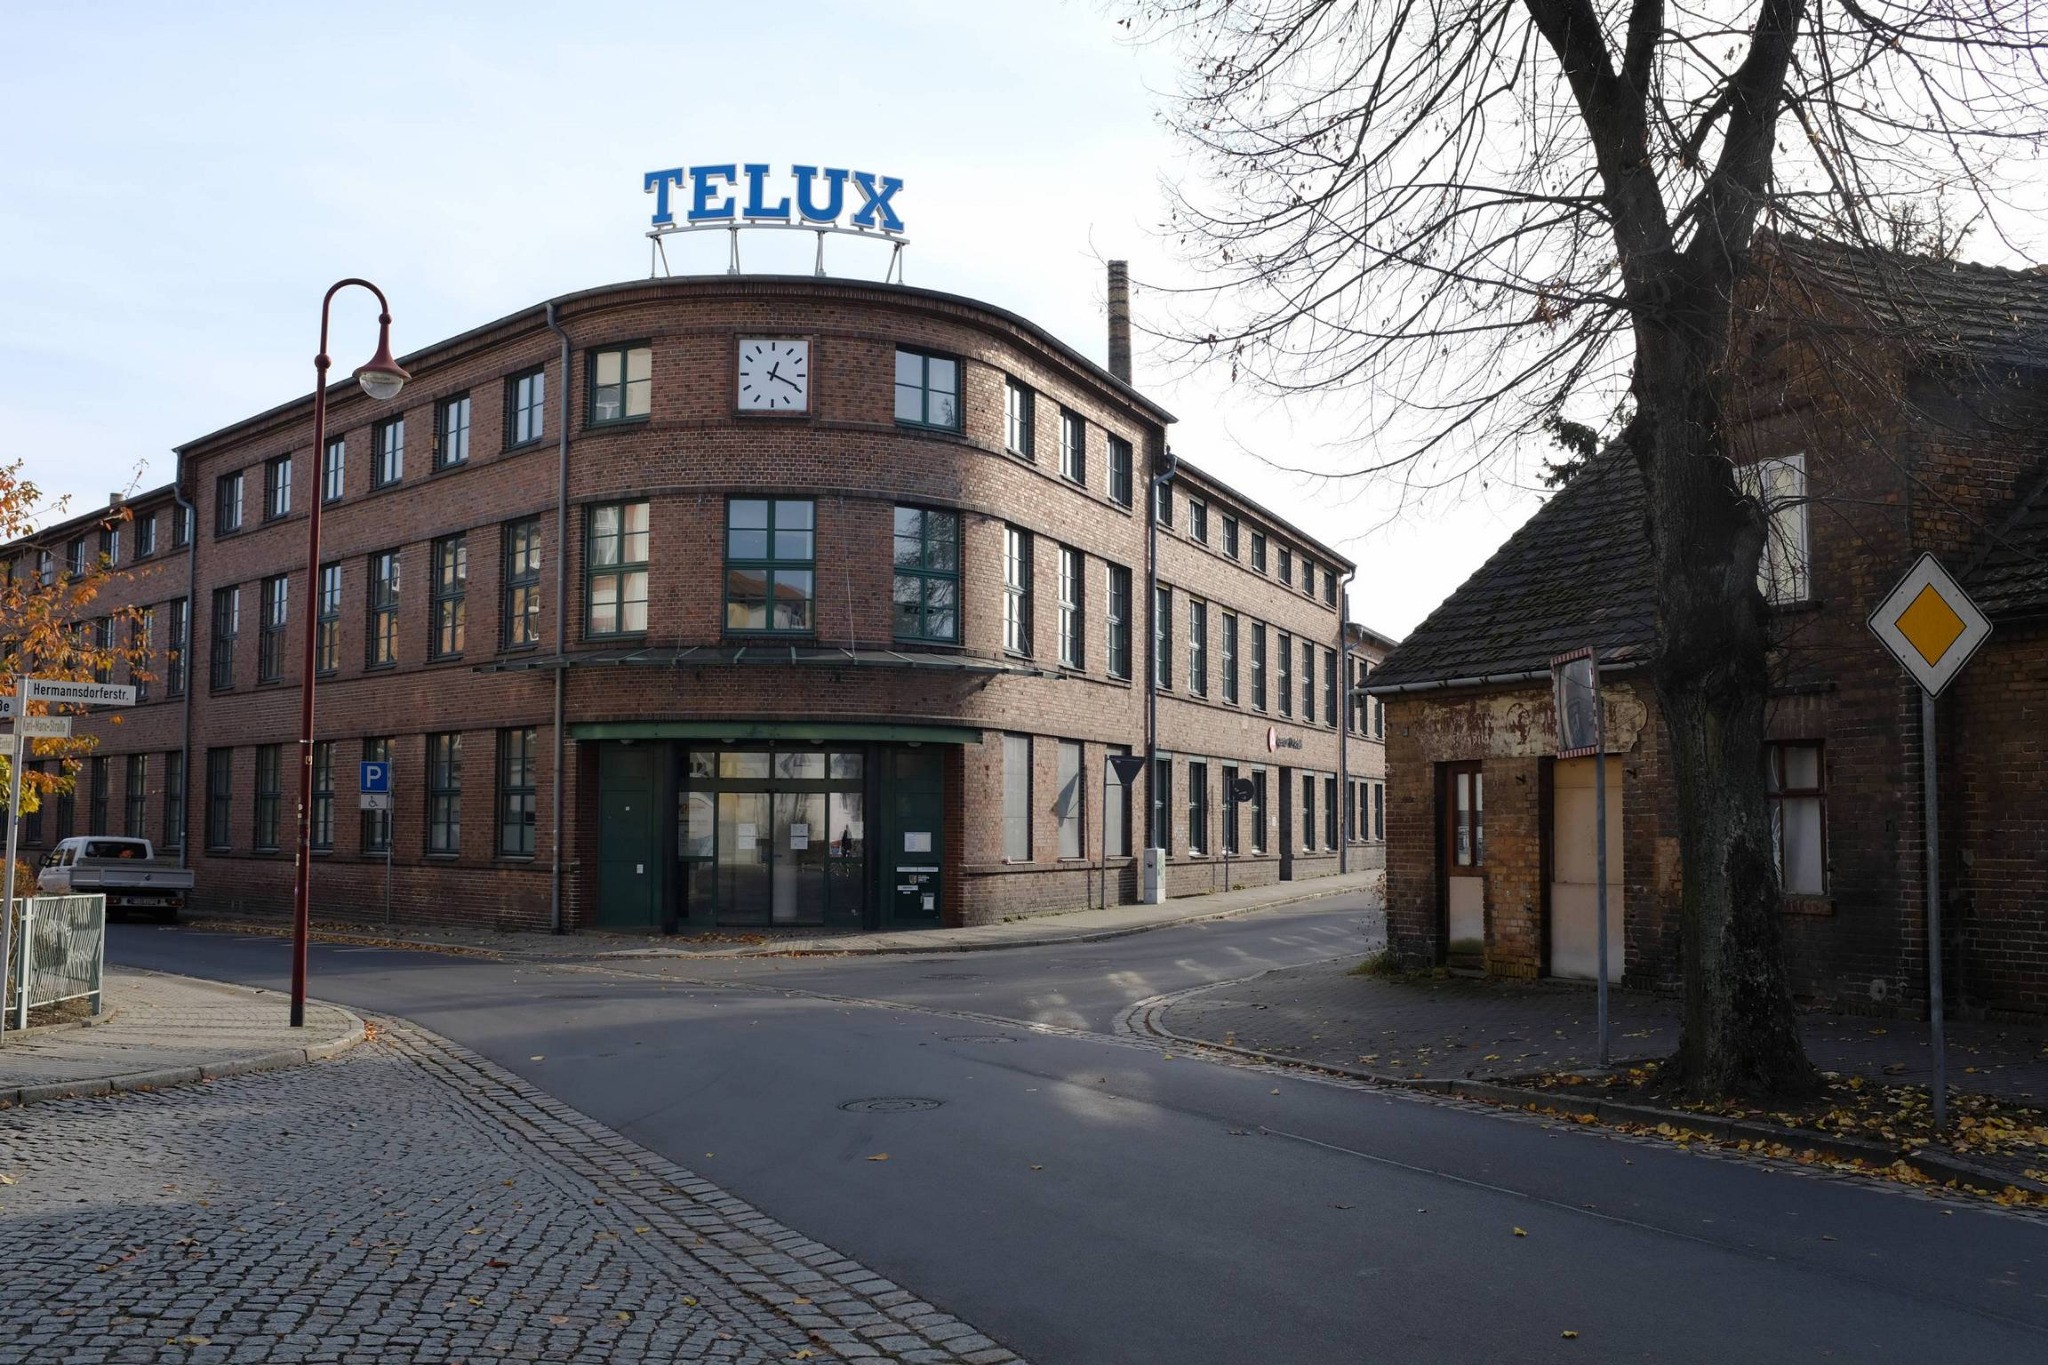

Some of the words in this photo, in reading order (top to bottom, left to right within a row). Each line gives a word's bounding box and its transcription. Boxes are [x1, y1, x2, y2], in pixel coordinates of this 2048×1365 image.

[643, 163, 905, 234] TELUX
[33, 683, 129, 700] Hermannsdorferstr.
[366, 766, 382, 788] P
